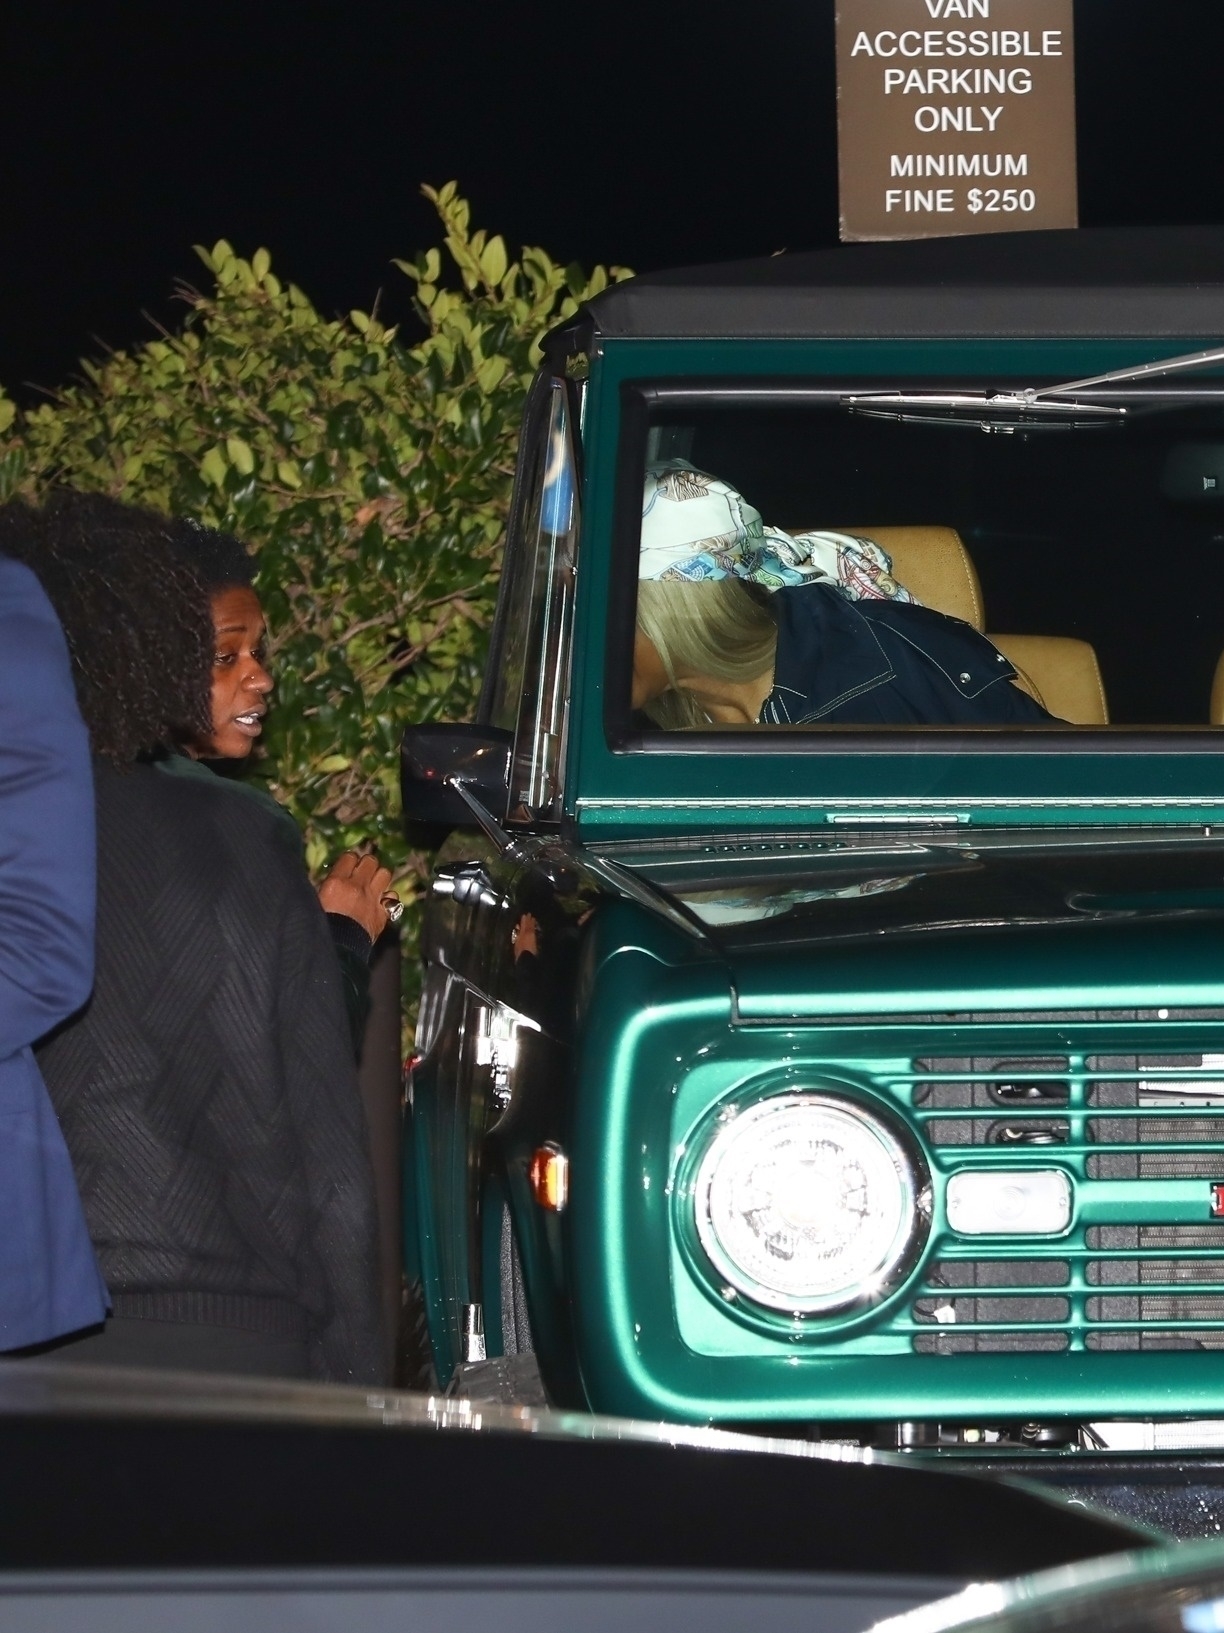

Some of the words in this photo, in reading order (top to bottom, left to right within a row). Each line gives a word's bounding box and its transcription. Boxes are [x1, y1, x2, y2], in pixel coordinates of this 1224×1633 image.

[924, 0, 990, 18] VAN
[850, 30, 1063, 57] ACCESSIBLE
[883, 68, 1033, 94] PARKING
[913, 105, 1003, 132] ONLY
[890, 154, 1028, 176] MINIMUM
[885, 189, 955, 212] FINE
[966, 188, 1036, 214] $250
